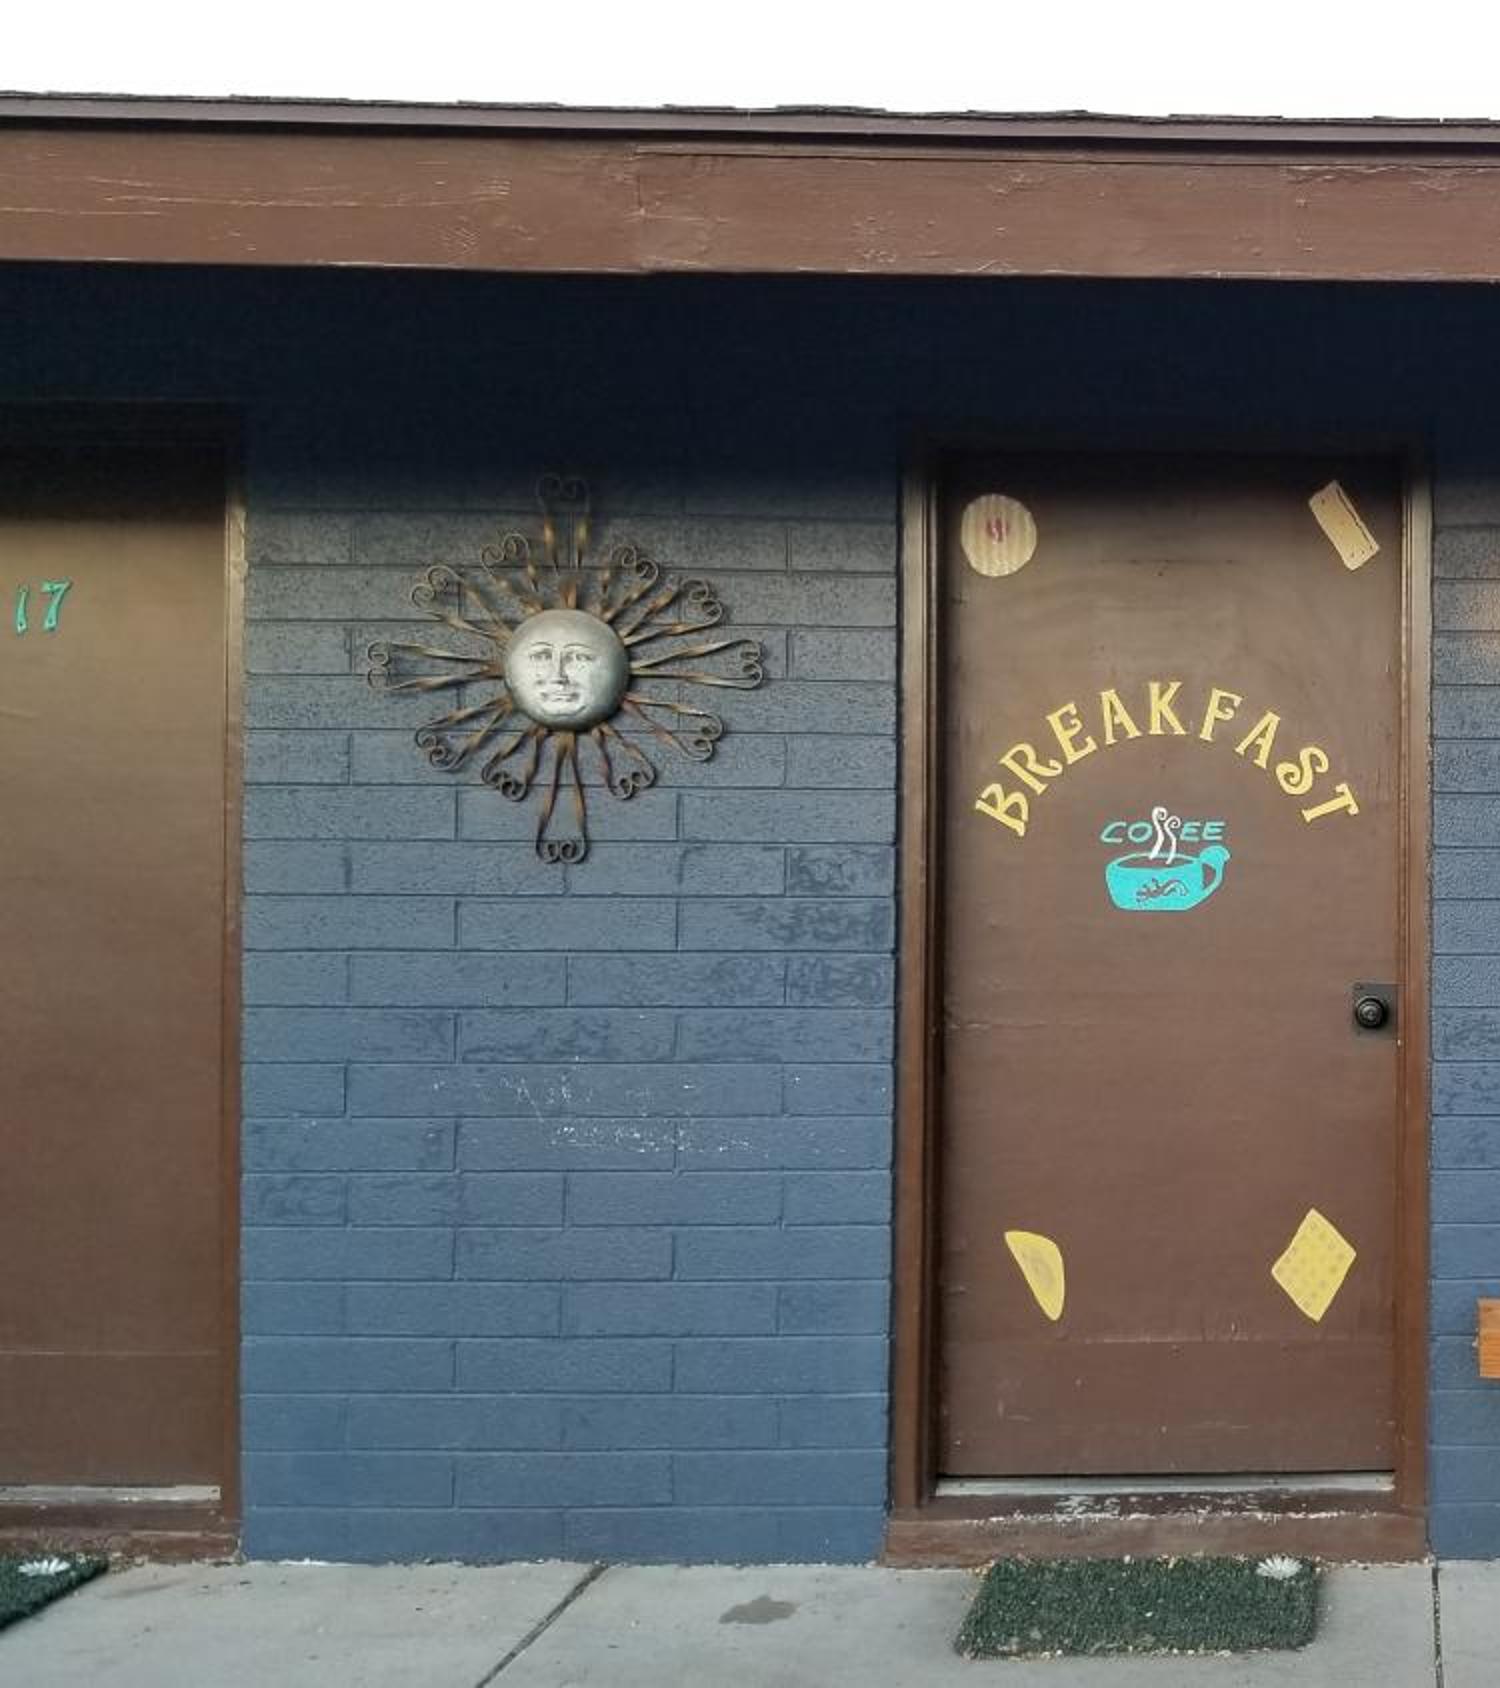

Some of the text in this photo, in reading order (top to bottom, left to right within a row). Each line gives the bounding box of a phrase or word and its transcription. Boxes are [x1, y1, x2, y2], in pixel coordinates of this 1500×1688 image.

[16, 579, 72, 635] 17
[975, 680, 1360, 837] BREAKFAST
[1101, 806, 1226, 864] COFFEE
